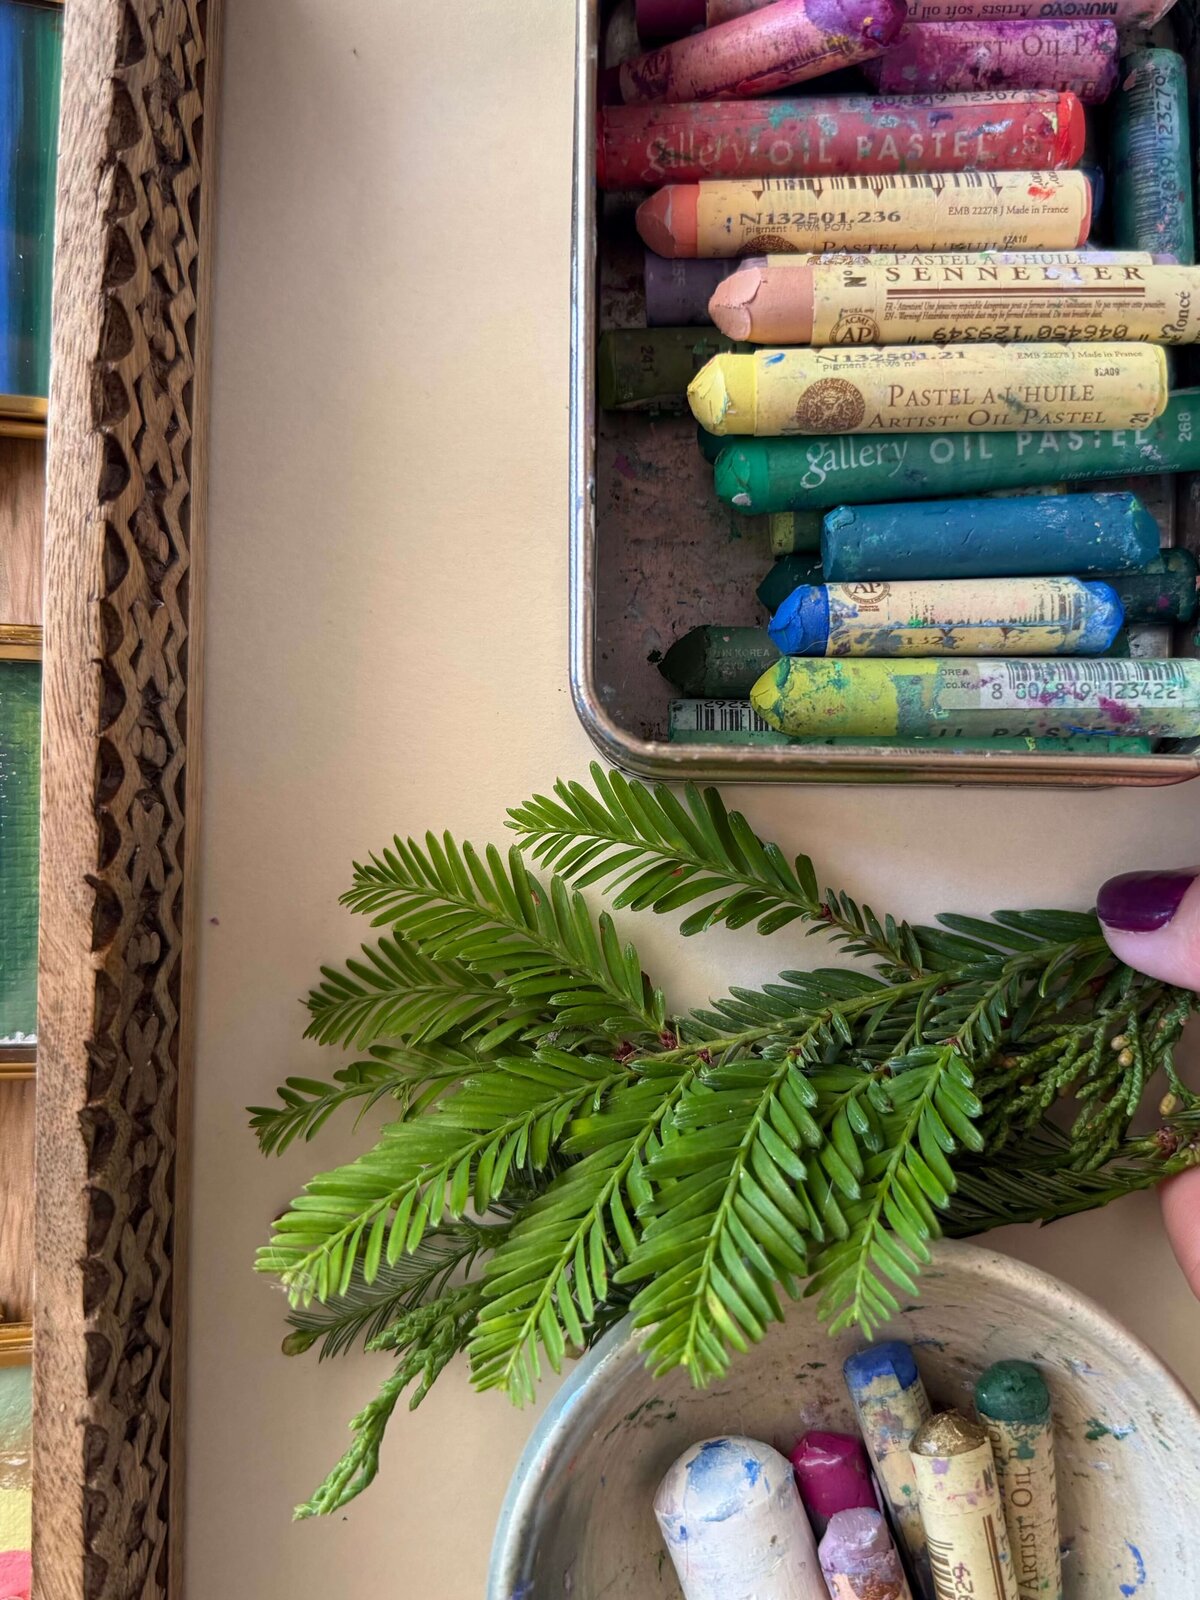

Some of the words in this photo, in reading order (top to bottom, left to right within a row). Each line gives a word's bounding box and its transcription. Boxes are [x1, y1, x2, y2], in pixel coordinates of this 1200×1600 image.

[921, 5, 942, 16] oil
[944, 5, 974, 16] soft
[975, 4, 1033, 18] Artists'
[1040, 2, 1118, 16] MUNGYO
[769, 136, 832, 164] OIL
[856, 130, 990, 161] PASTEL
[739, 210, 902, 226] N132501.236
[949, 206, 969, 216] EMB
[972, 205, 998, 215] 22278
[1007, 204, 1029, 214] Made
[1031, 204, 1040, 214] in
[1042, 204, 1069, 214] France
[895, 253, 977, 266] PASTEL
[885, 266, 1146, 282] SENNELIER
[839, 326, 873, 343] AP
[1078, 351, 1103, 359] Made
[1115, 349, 1145, 358] France
[887, 384, 975, 408] PASTEL
[868, 415, 960, 430] ARTIST'
[967, 409, 1013, 426] OIL
[1022, 408, 1108, 425] PASTEL
[800, 436, 908, 490] gallery
[929, 434, 993, 464] OIL
[1177, 411, 1193, 443] 268
[940, 669, 969, 677] OREA
[991, 682, 1003, 700] 8
[1011, 1466, 1034, 1508] OIL
